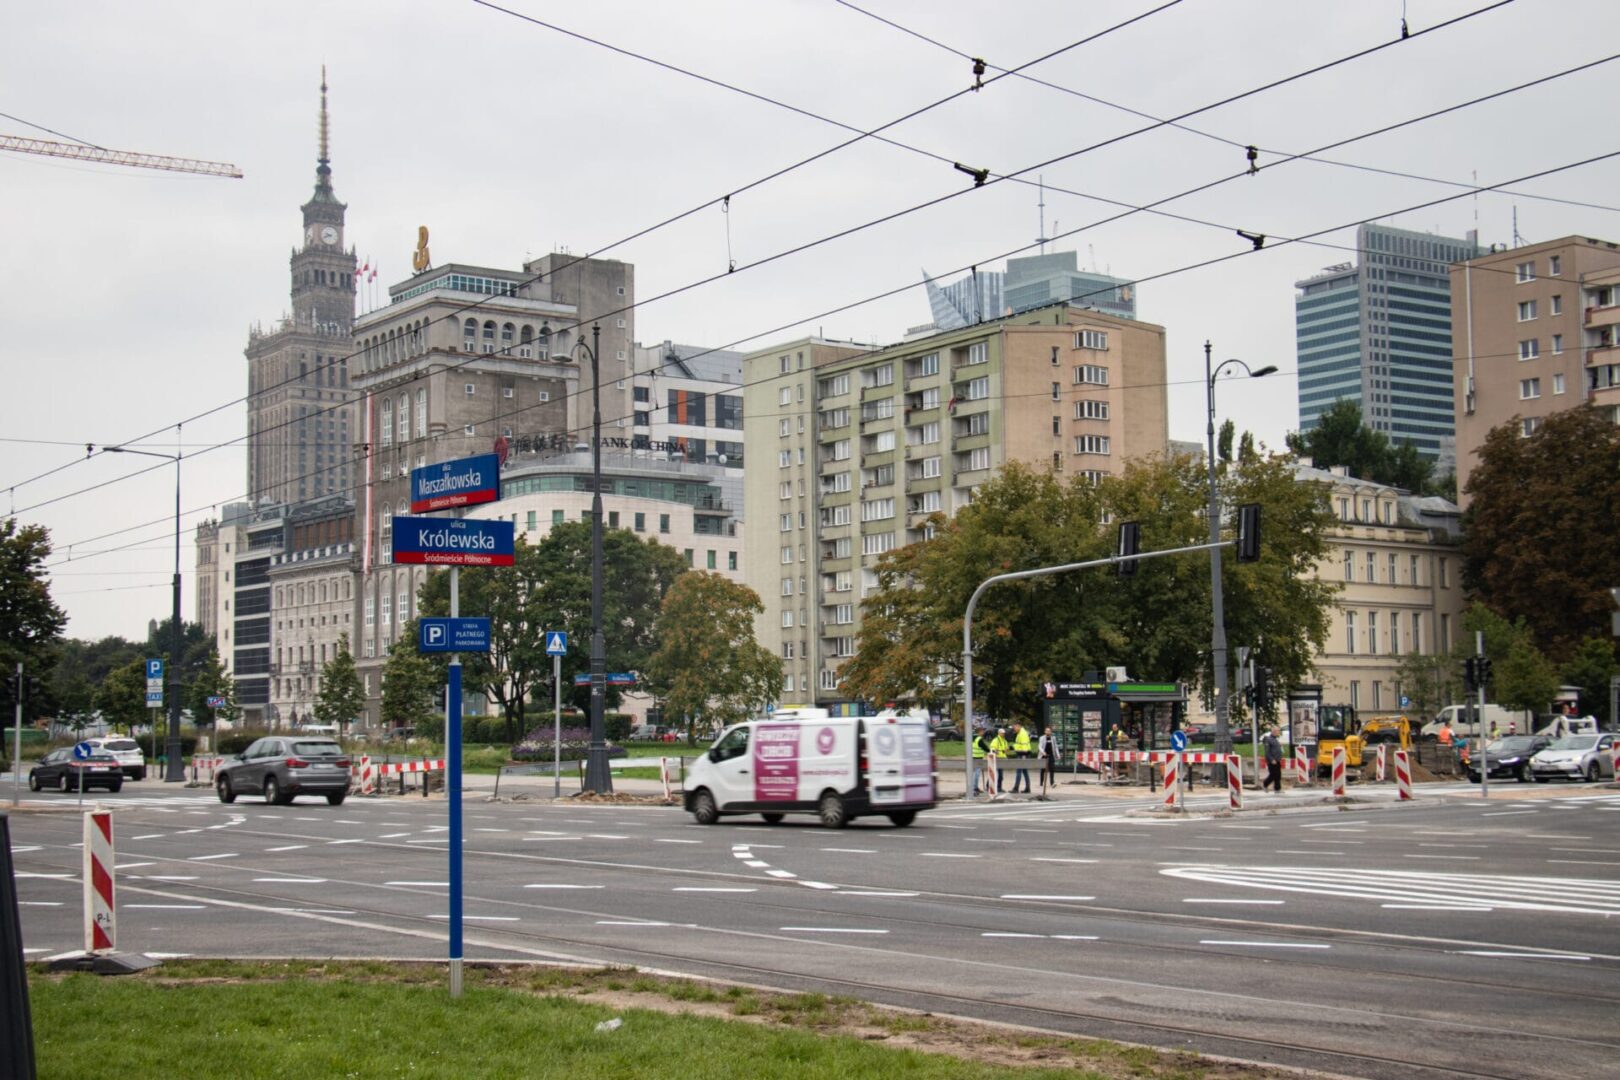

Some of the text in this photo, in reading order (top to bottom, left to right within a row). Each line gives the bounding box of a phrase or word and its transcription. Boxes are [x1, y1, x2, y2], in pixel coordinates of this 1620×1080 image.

[592, 436, 629, 449] ANK
[649, 440, 686, 454] CHINA
[419, 468, 481, 495] Marszałkowska
[450, 521, 467, 529] ulica
[418, 529, 495, 550] Królewska
[424, 553, 492, 565] Śródmieście Północne
[429, 626, 442, 643] P
[150, 661, 161, 674] P
